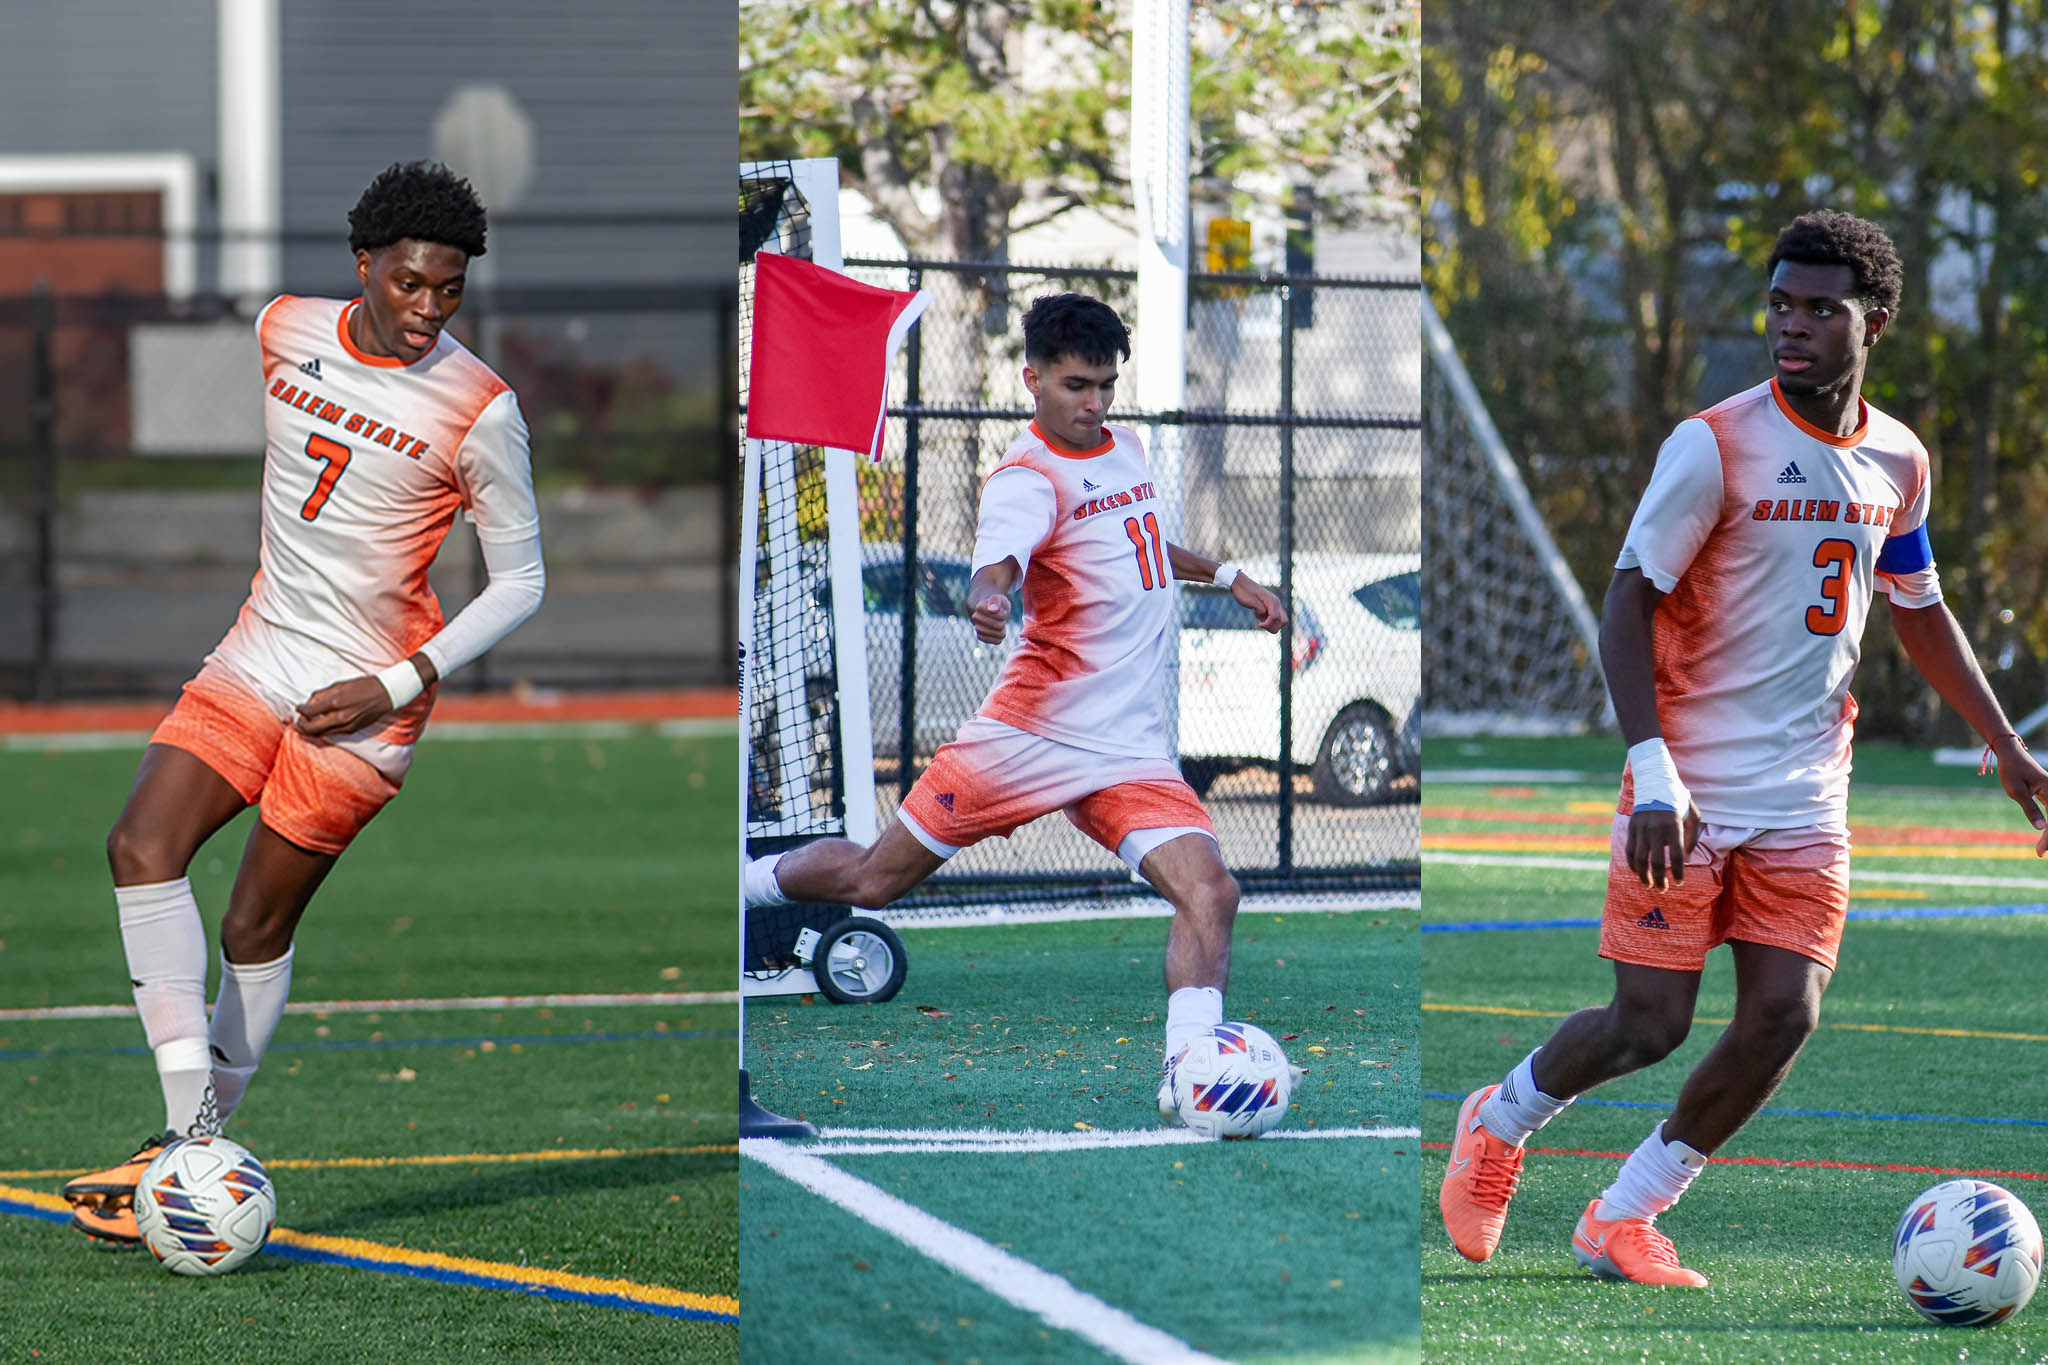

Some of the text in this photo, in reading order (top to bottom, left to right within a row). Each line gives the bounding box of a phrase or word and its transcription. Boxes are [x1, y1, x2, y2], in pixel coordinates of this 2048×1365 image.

[270, 378, 431, 460] SALEM STATE
[299, 432, 352, 522] 7
[1073, 482, 1157, 521] SALEM STA
[1776, 475, 1807, 484] adidas
[1752, 499, 1895, 527] SALEM STAT
[1123, 511, 1167, 591] 11
[1805, 538, 1857, 637] 3
[1637, 920, 1670, 930] adidas
